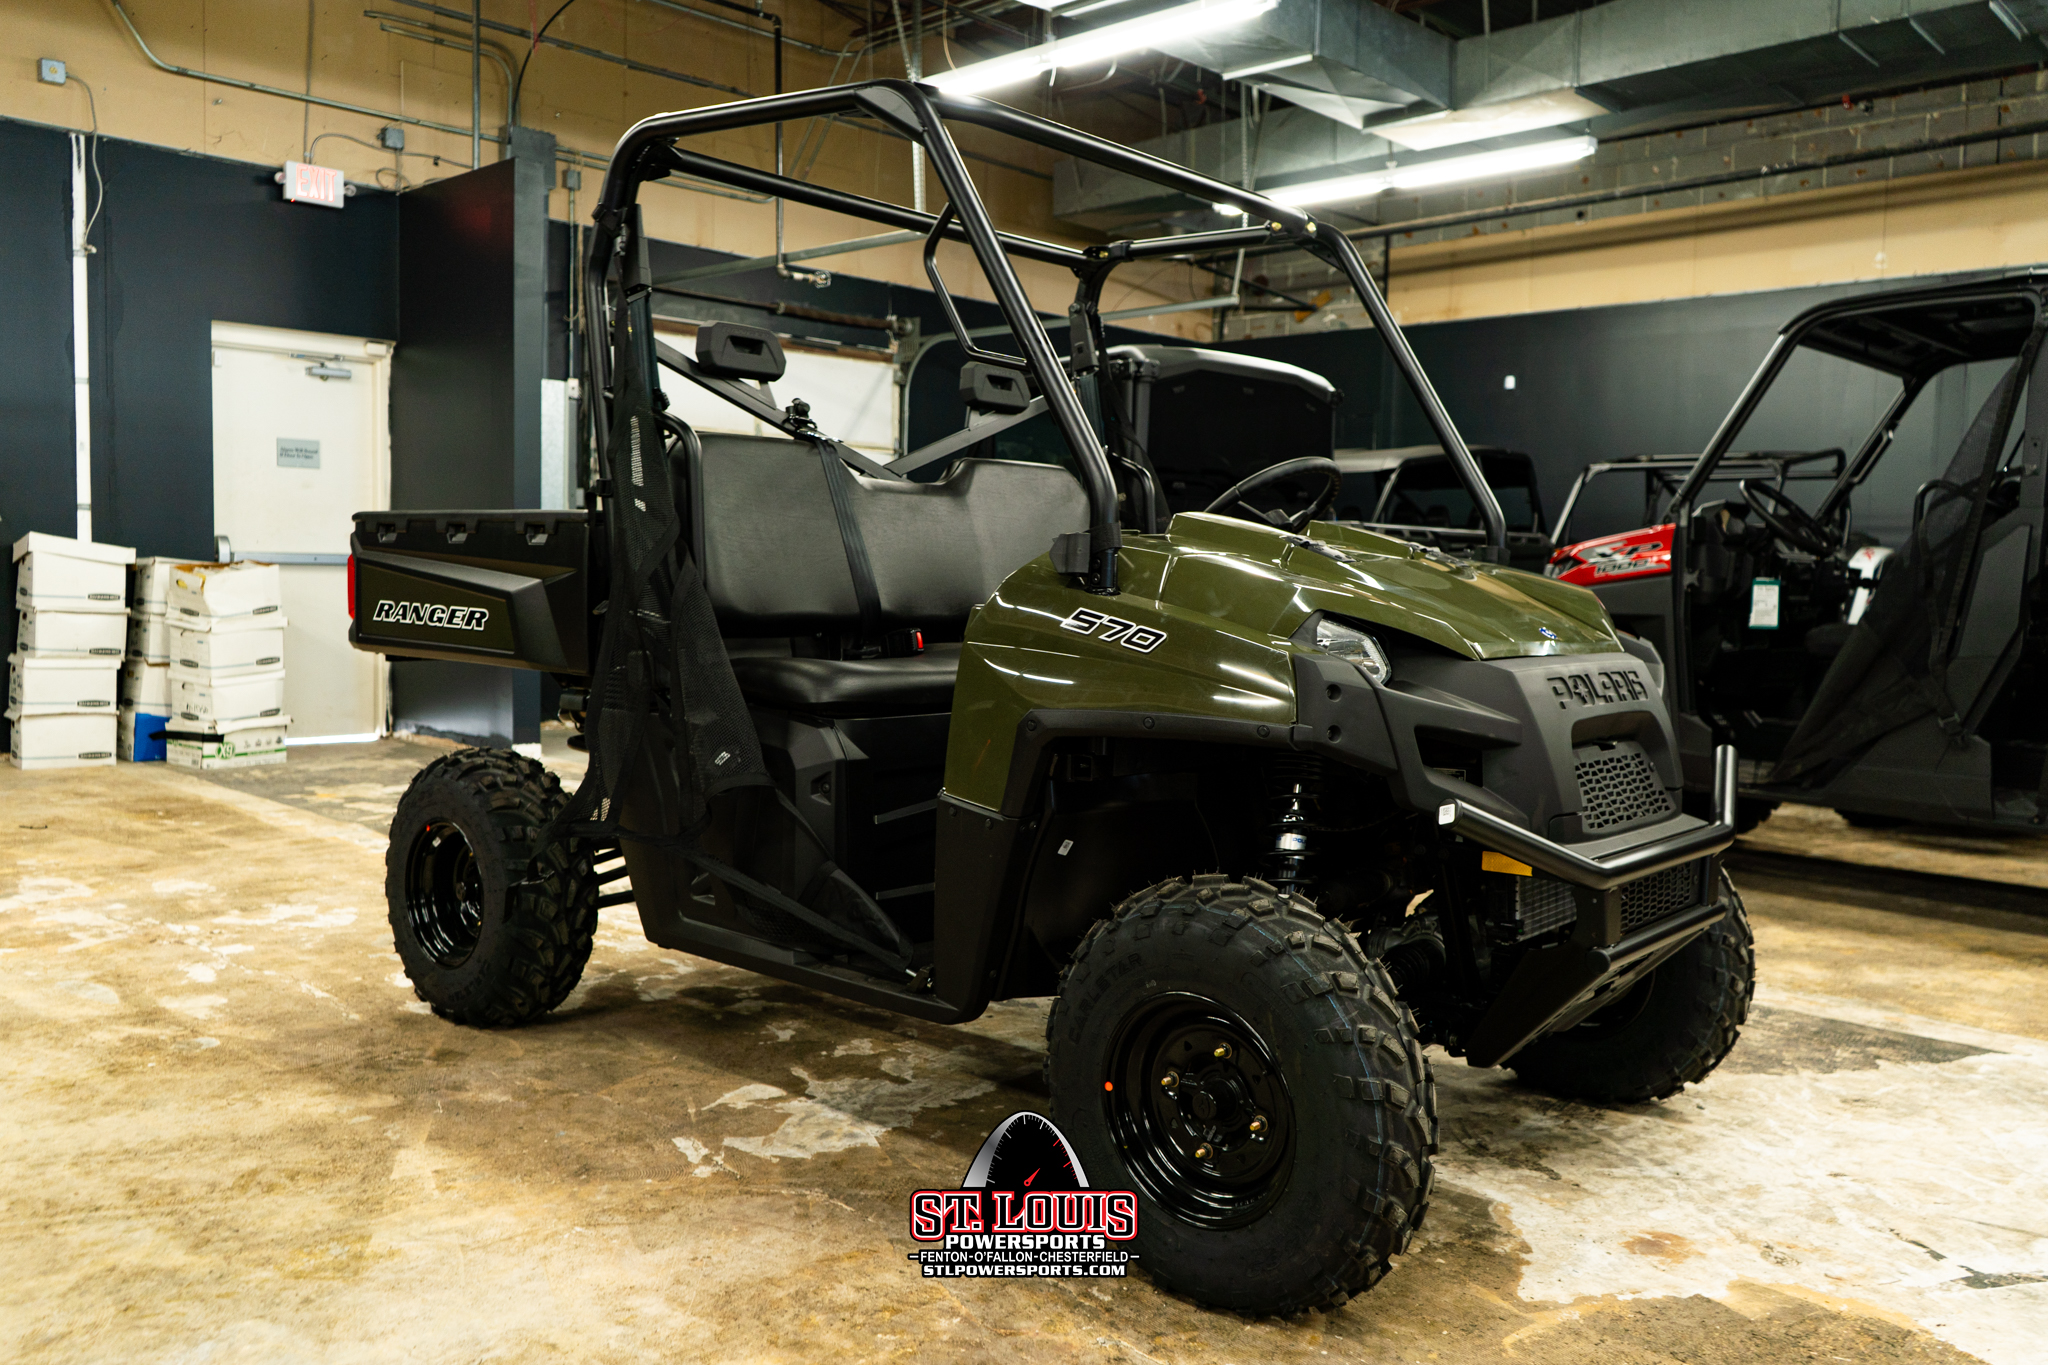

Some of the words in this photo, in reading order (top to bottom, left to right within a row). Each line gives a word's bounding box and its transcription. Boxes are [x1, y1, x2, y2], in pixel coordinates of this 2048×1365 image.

[296, 163, 337, 203] EXIT
[373, 600, 489, 631] RANGER
[1060, 607, 1167, 653] 570
[1547, 670, 1648, 710] POLARIS
[1069, 953, 1144, 1045] CARLSTAR
